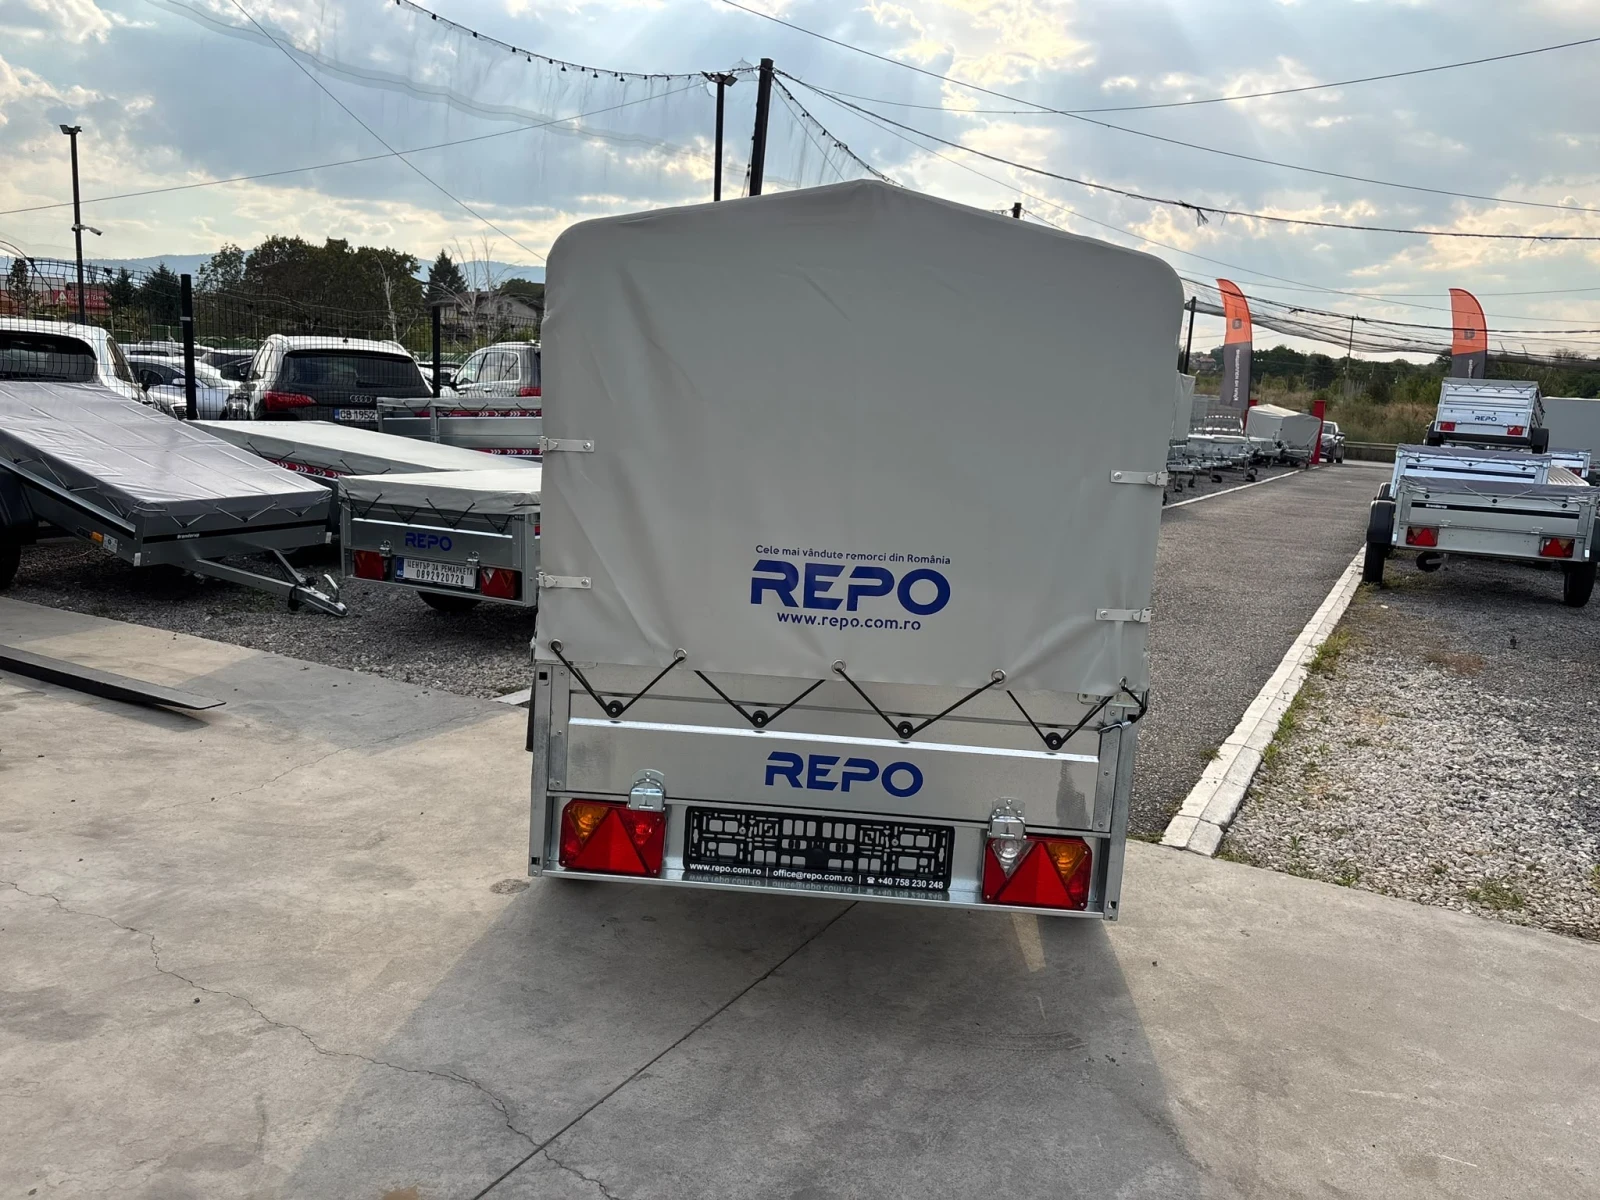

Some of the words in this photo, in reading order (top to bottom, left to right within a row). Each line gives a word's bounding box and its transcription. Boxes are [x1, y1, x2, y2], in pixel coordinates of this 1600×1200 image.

[405, 532, 452, 552] REPO
[755, 544, 780, 555] Cele
[782, 547, 801, 557] mai
[802, 548, 844, 560] vândute
[845, 552, 887, 562] remorci
[888, 552, 905, 563] din
[906, 554, 951, 565] România
[407, 560, 430, 569] ЦЕНТЪР
[432, 563, 439, 571] ЗА
[750, 559, 951, 616] REPO
[777, 612, 921, 631] www.repo.com.ro
[764, 751, 924, 798] REPO
[689, 863, 762, 875] www.repo.com.ro
[773, 869, 853, 883] office@repo.com.ro
[877, 877, 893, 886] +40
[895, 878, 910, 887] 758
[911, 879, 927, 888] 230
[928, 880, 944, 890] 248
